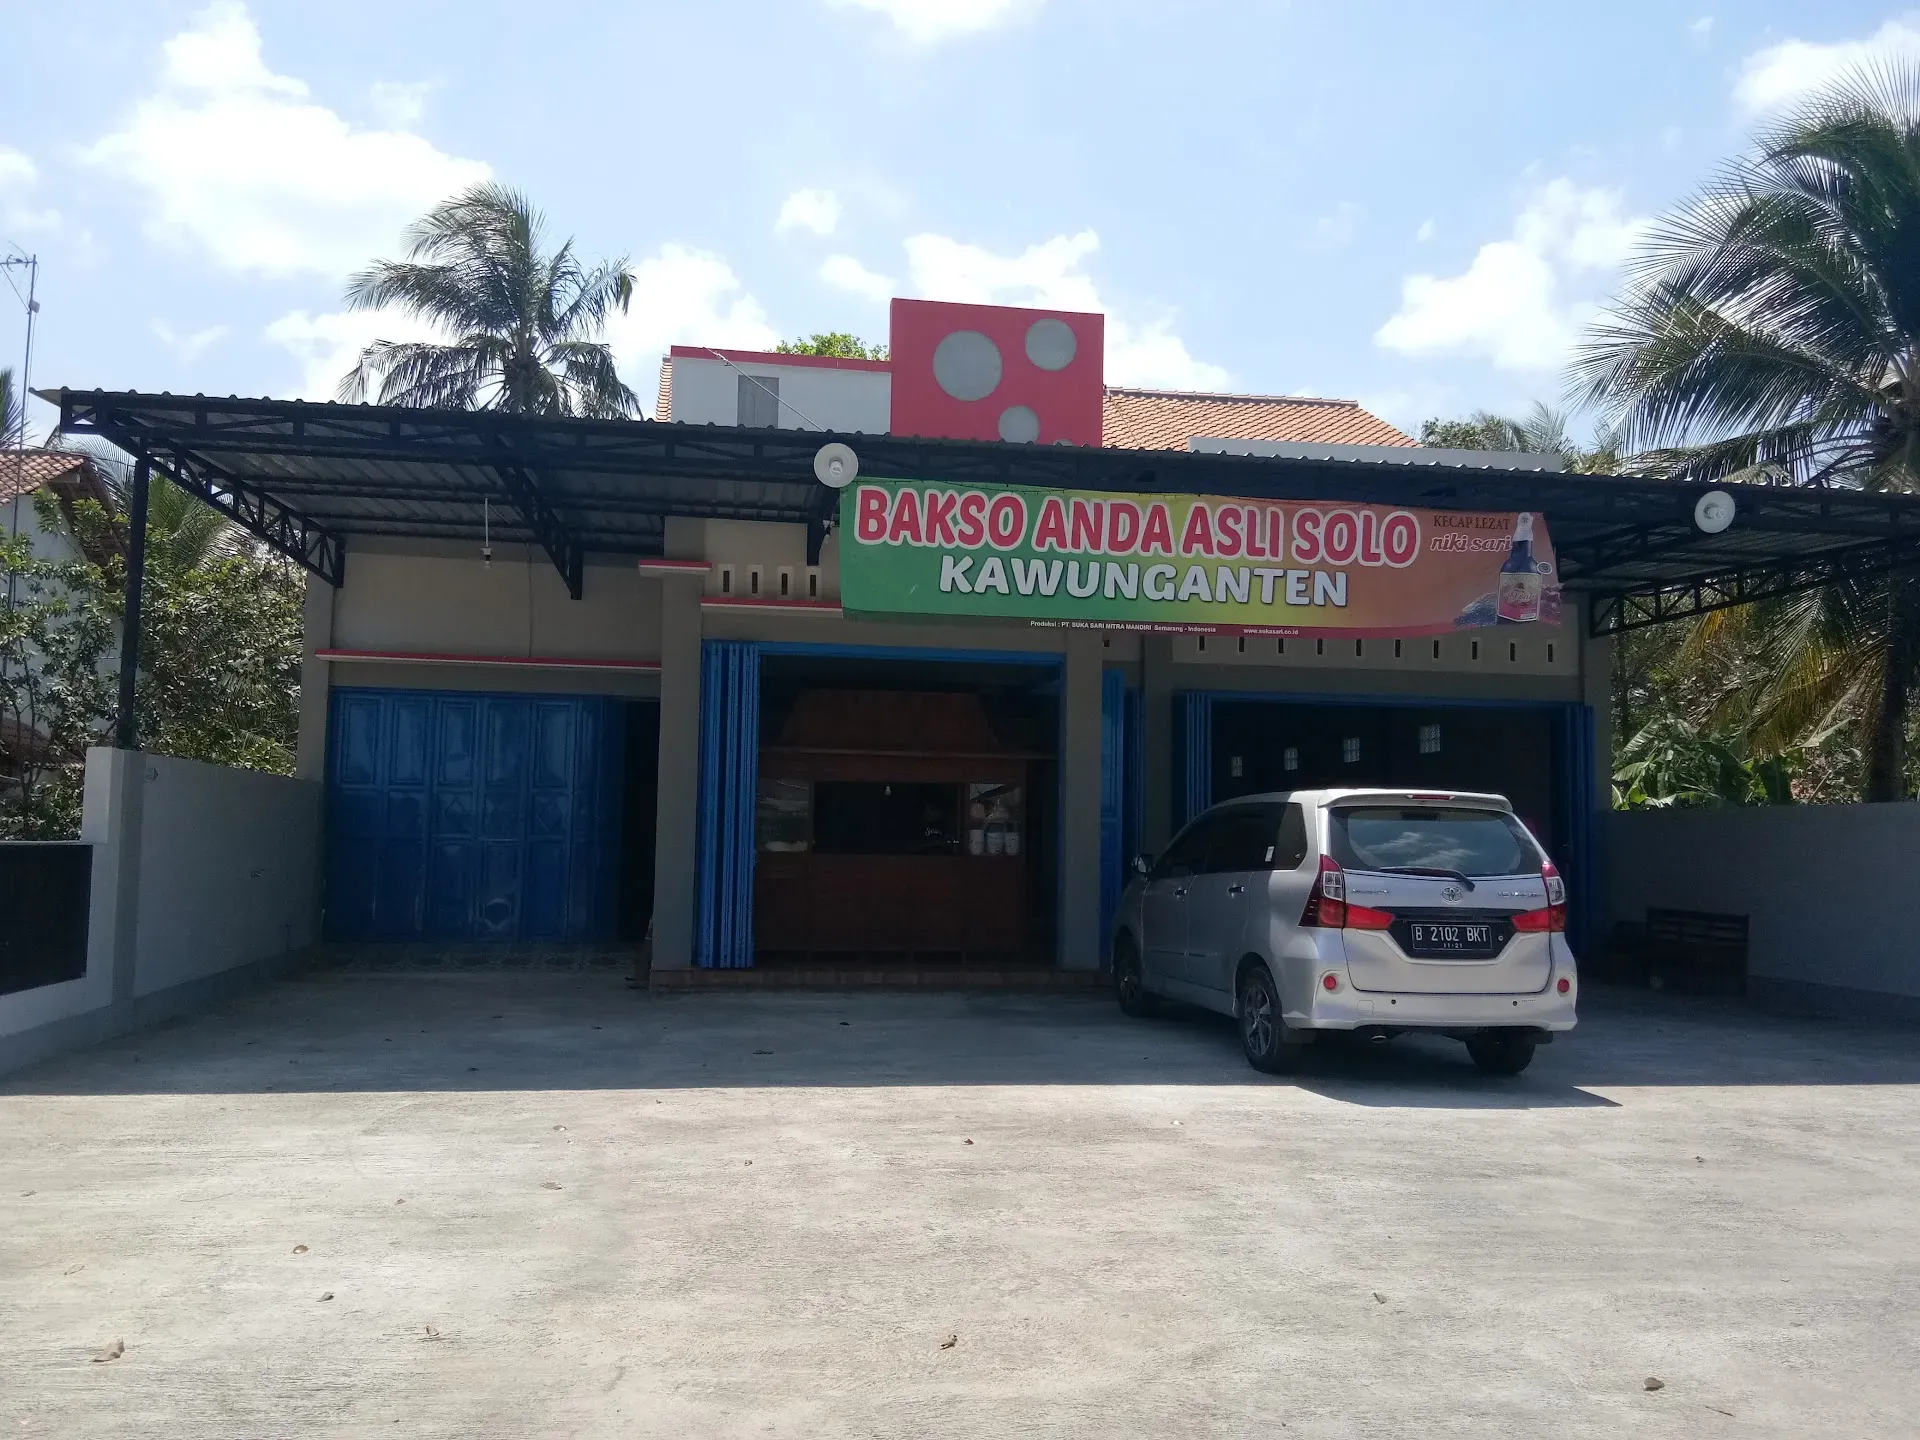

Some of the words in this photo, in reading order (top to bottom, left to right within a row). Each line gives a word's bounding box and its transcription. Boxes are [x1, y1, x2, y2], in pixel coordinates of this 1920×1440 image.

[854, 486, 1028, 551] BAKSO
[1031, 496, 1174, 555] ANDA
[1180, 501, 1284, 564] ASLI
[1291, 507, 1421, 568] SOLO
[1433, 515, 1472, 528] KECAP
[1475, 517, 1510, 530] LEZAT
[1430, 532, 1468, 552] niki
[1469, 535, 1513, 552] sari
[939, 555, 1348, 607] KAWUNGANTEN
[1071, 621, 1089, 629] SUKA
[1090, 622, 1105, 630] SARI
[1415, 926, 1423, 941] B
[1430, 926, 1460, 942] 2102
[1466, 927, 1488, 942] BKT
